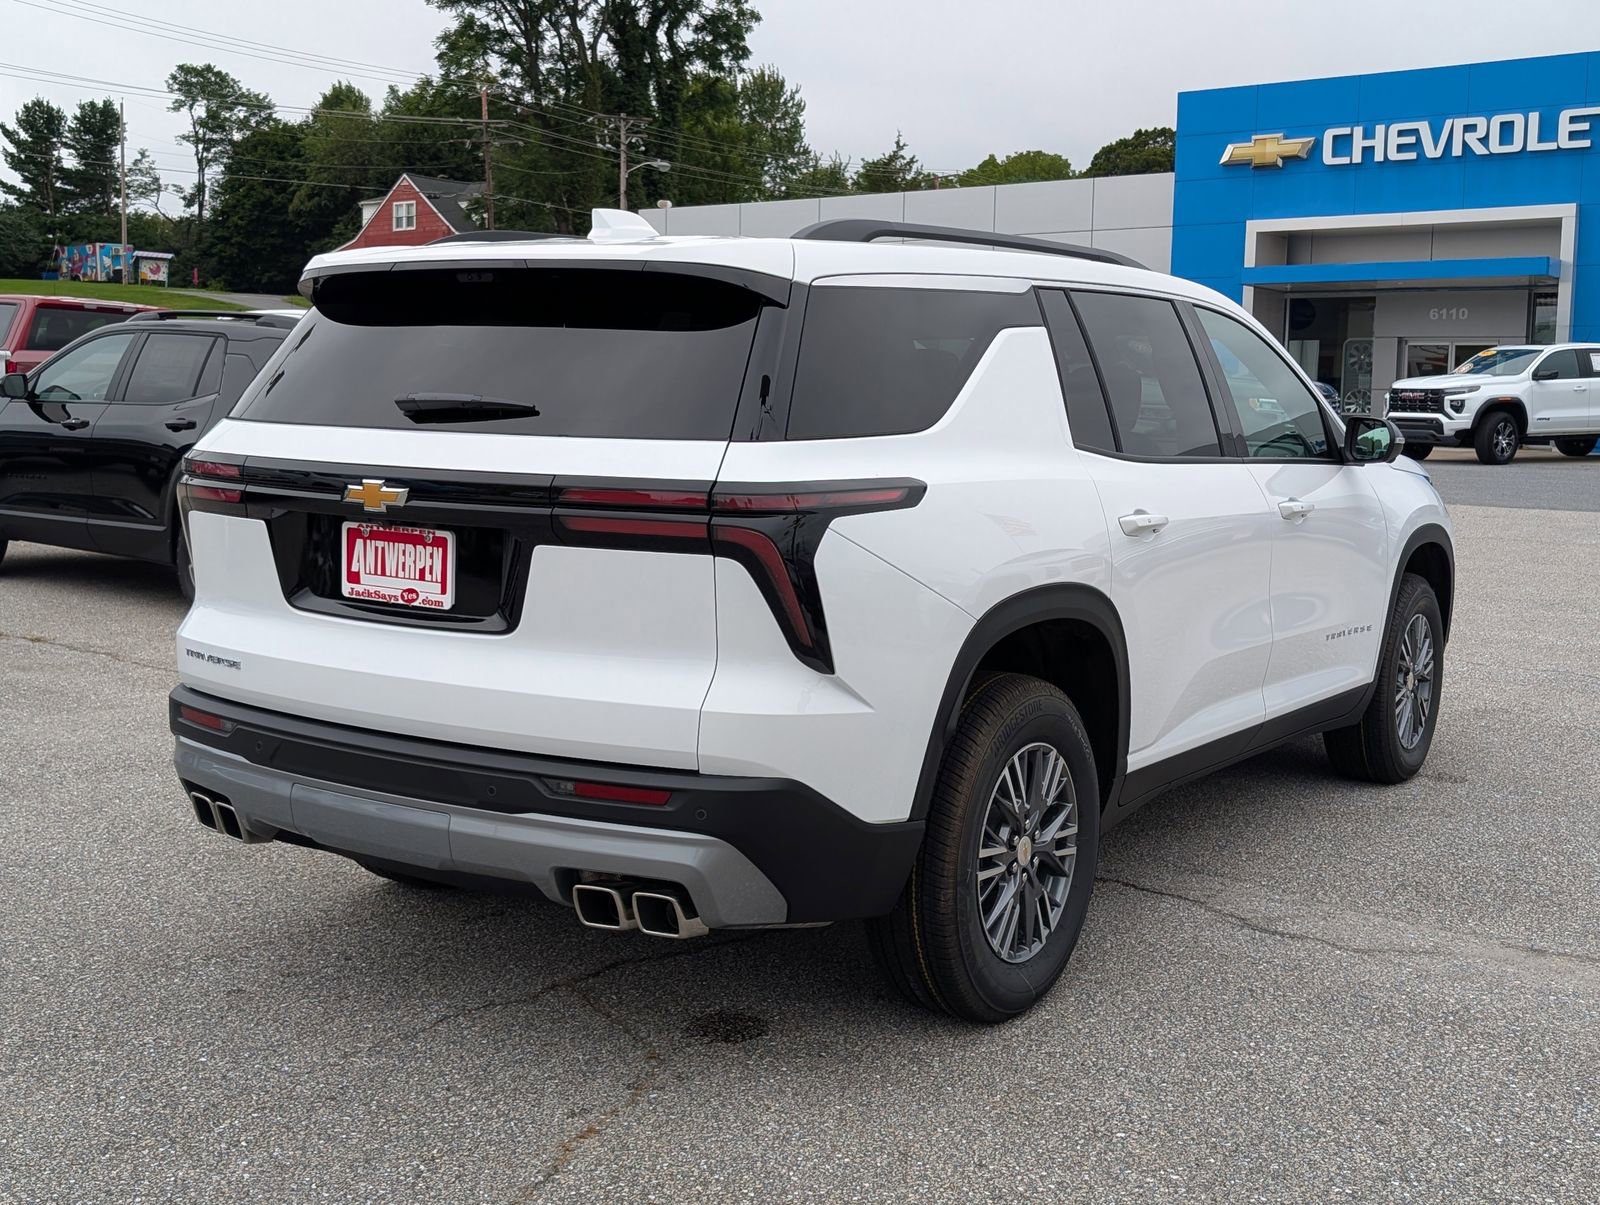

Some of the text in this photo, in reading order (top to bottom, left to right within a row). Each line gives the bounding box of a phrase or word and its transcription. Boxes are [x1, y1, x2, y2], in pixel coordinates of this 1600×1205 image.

[1322, 107, 1600, 166] CHEVROLE
[1429, 307, 1469, 320] 6110
[356, 523, 436, 536] ANTWERPEN
[351, 538, 443, 584] ANTWERPEN
[1325, 624, 1373, 641] TRAVERSE
[185, 648, 242, 670] TRAVERSE
